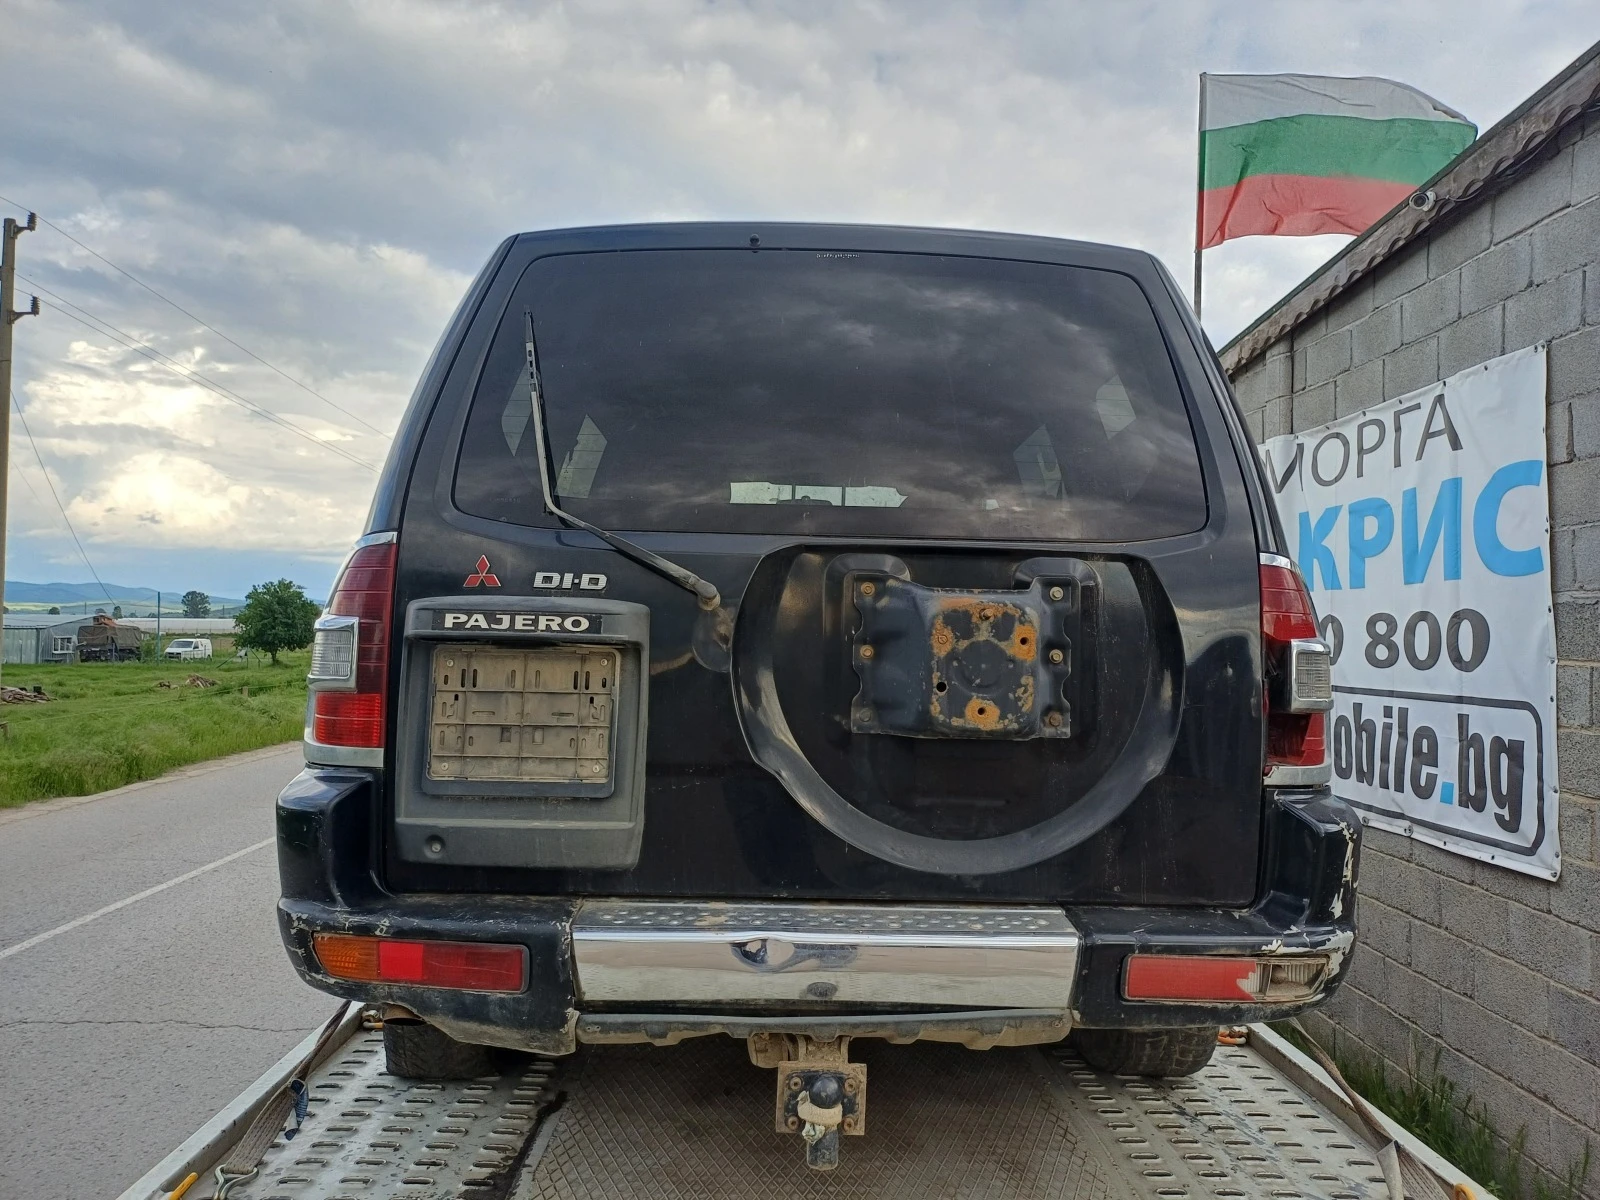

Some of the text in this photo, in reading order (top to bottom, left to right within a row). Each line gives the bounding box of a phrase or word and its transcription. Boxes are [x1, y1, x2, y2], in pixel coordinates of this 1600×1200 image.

[1298, 459, 1544, 593] КРИС
[533, 571, 608, 590] DI-D
[444, 612, 590, 632] PAJERO
[1365, 608, 1491, 672] 800
